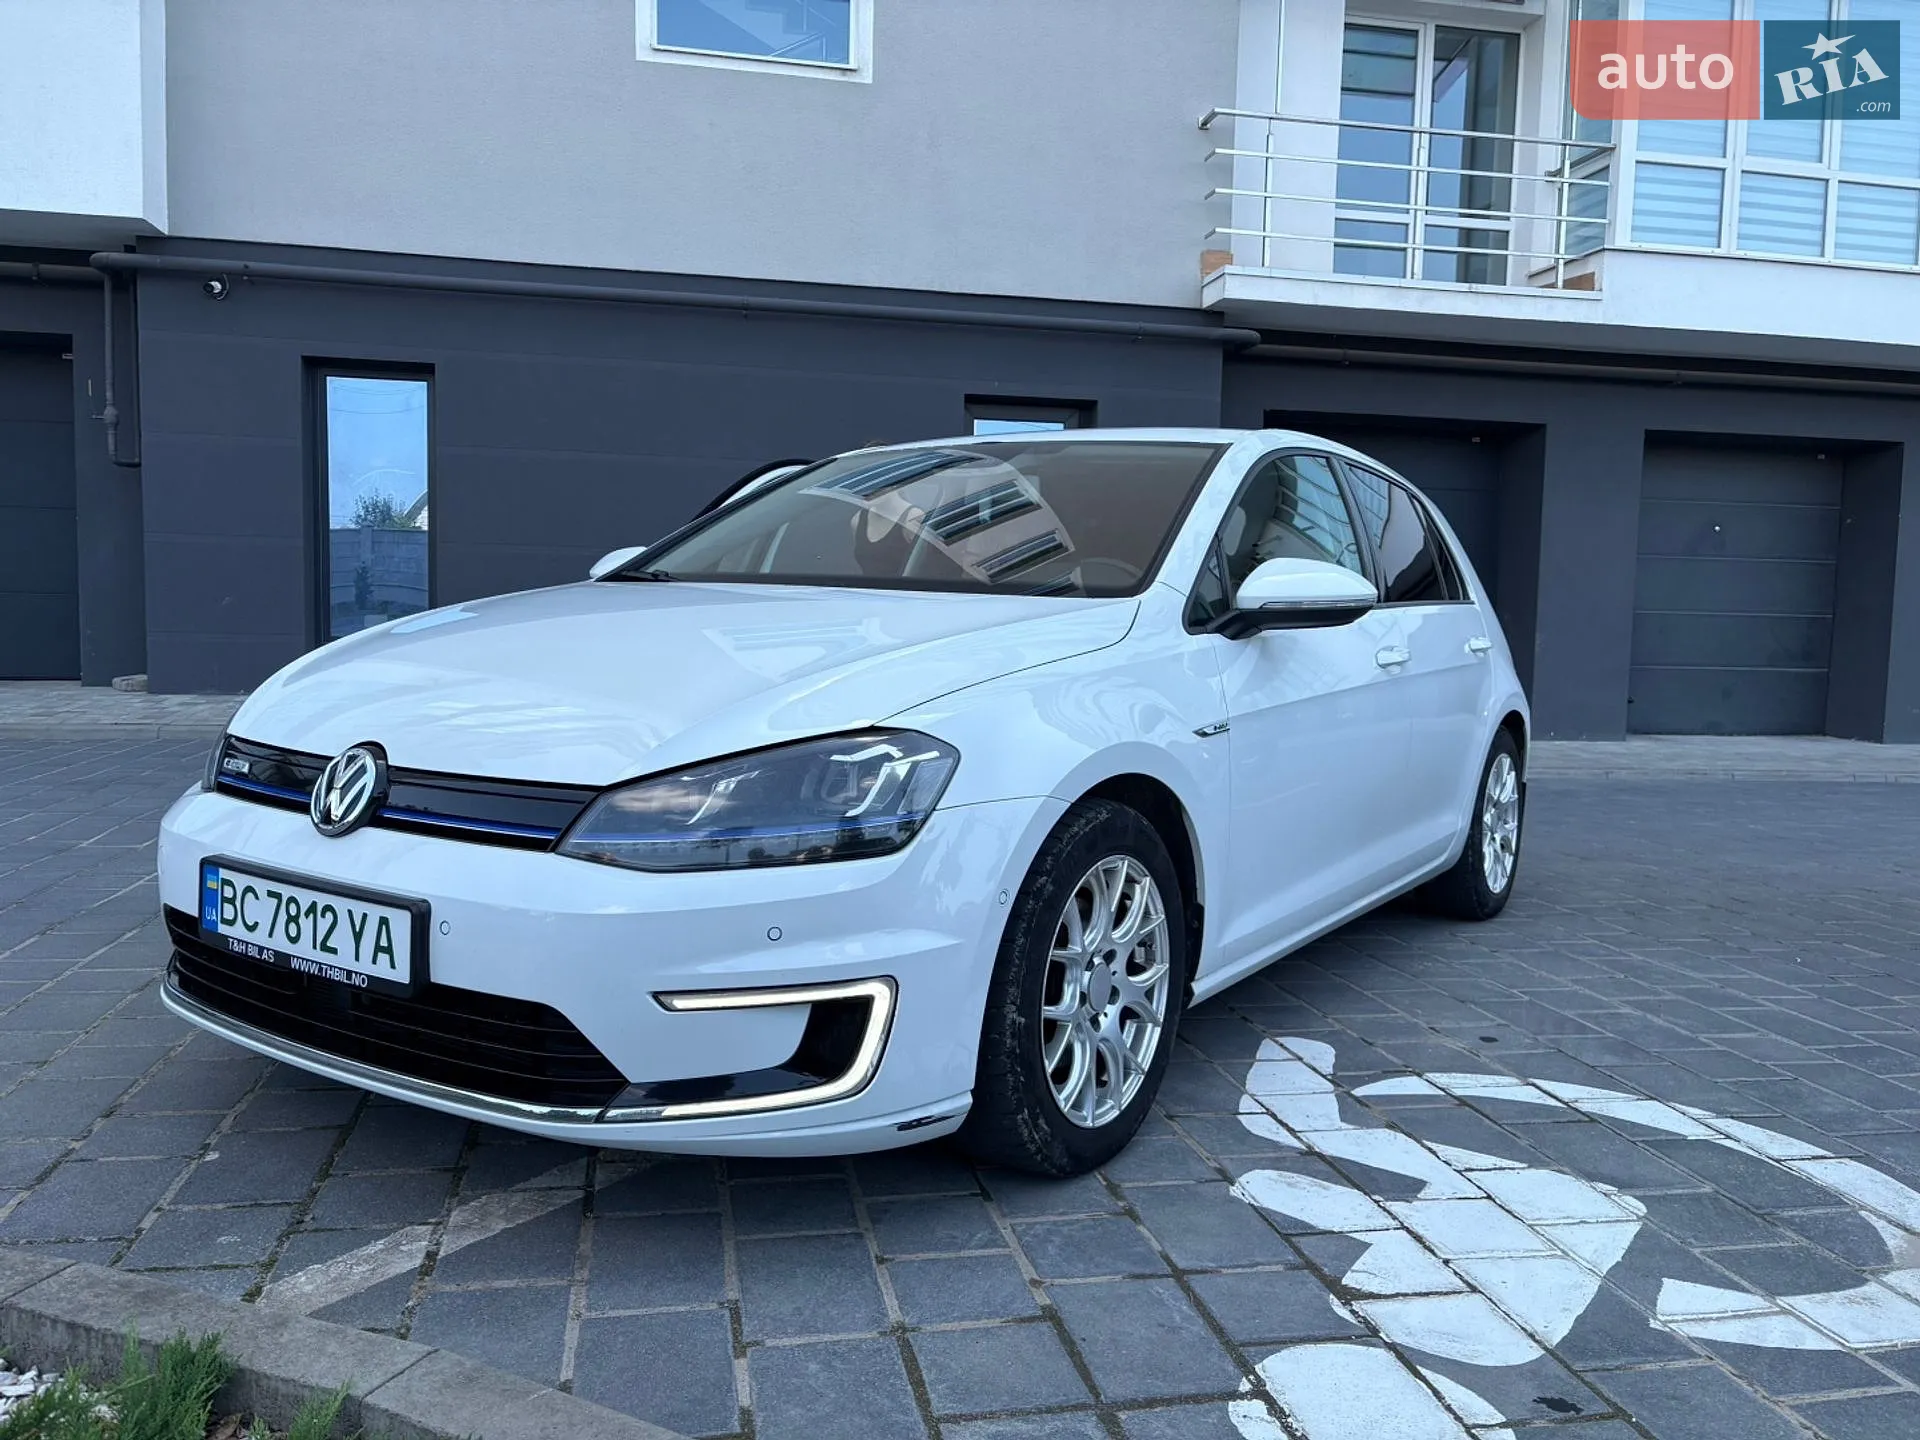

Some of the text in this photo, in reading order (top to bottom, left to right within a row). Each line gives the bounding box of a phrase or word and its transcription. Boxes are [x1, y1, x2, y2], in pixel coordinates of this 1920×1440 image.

[205, 905, 217, 922] UA
[227, 937, 246, 955] T&H
[290, 956, 368, 988] WWW.THBIL.NO
